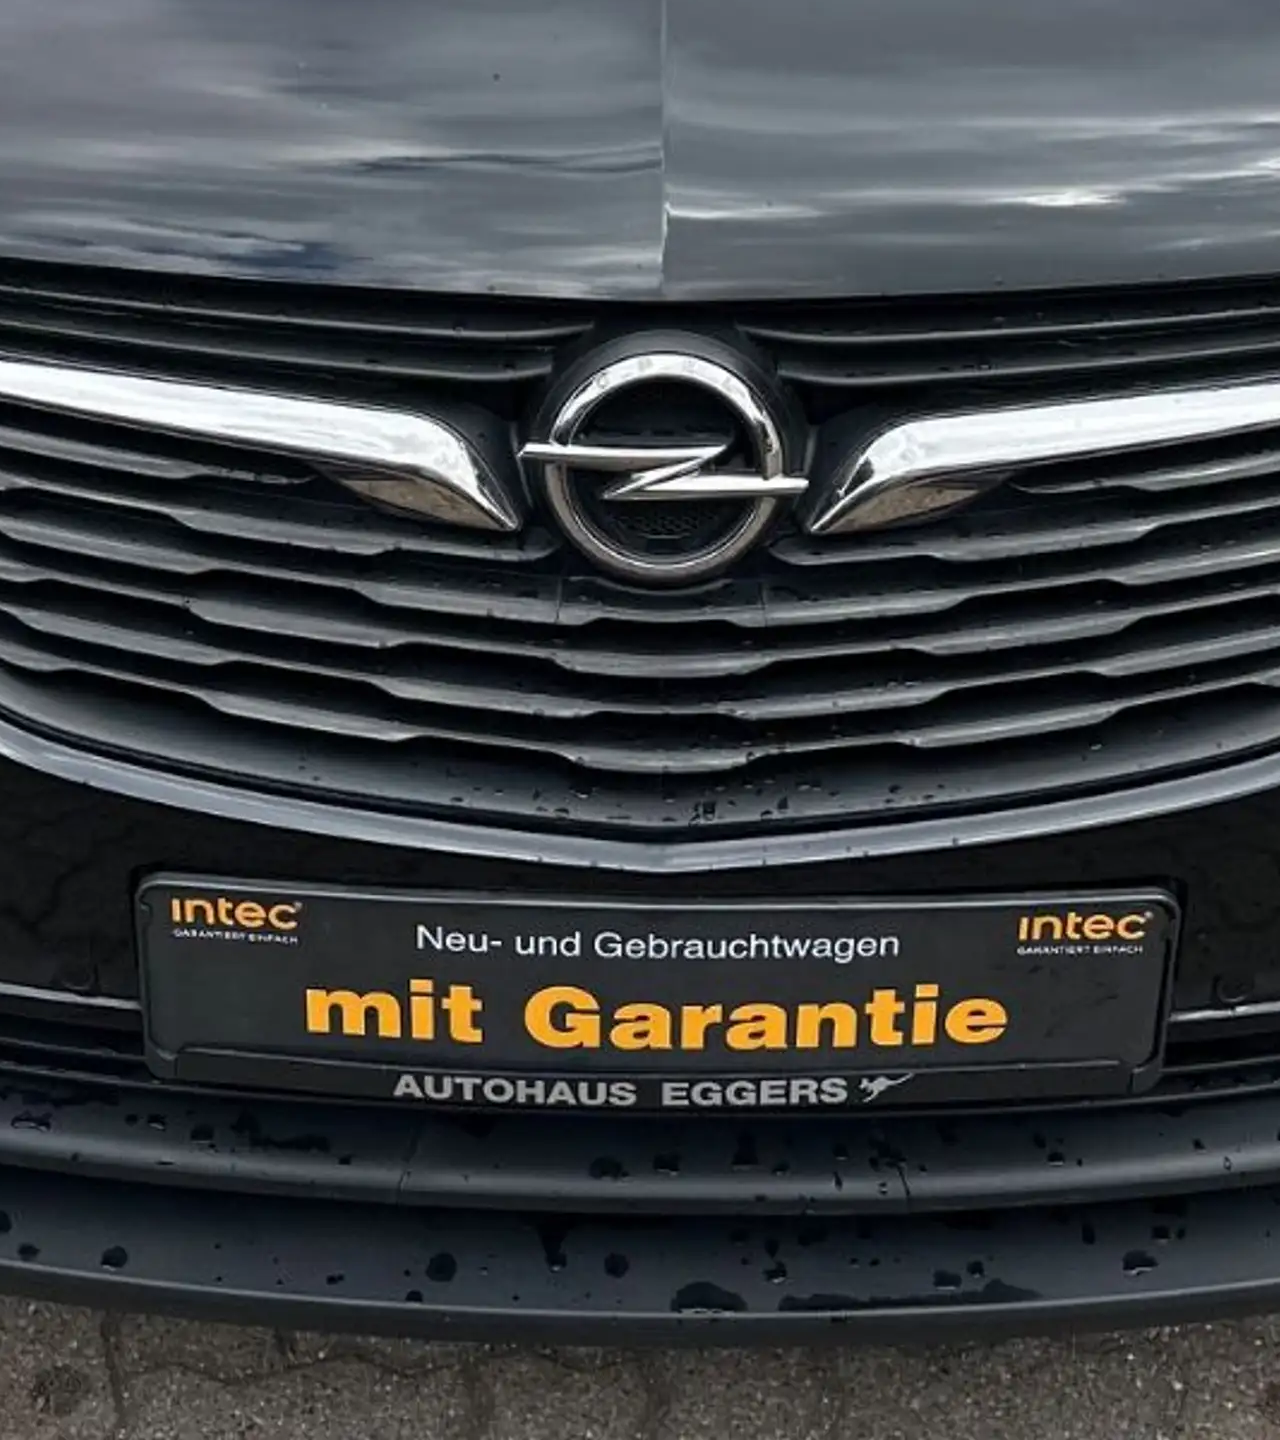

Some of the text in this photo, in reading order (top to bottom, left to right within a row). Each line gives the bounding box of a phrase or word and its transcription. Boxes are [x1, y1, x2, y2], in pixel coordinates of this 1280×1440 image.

[171, 898, 297, 930] intec
[1018, 912, 1147, 941] intec
[416, 923, 901, 965] Neu- und Gebrauchtwagen
[305, 978, 1008, 1051] mit Garantie
[393, 1074, 849, 1107] AUTOHAUS EGGERS
